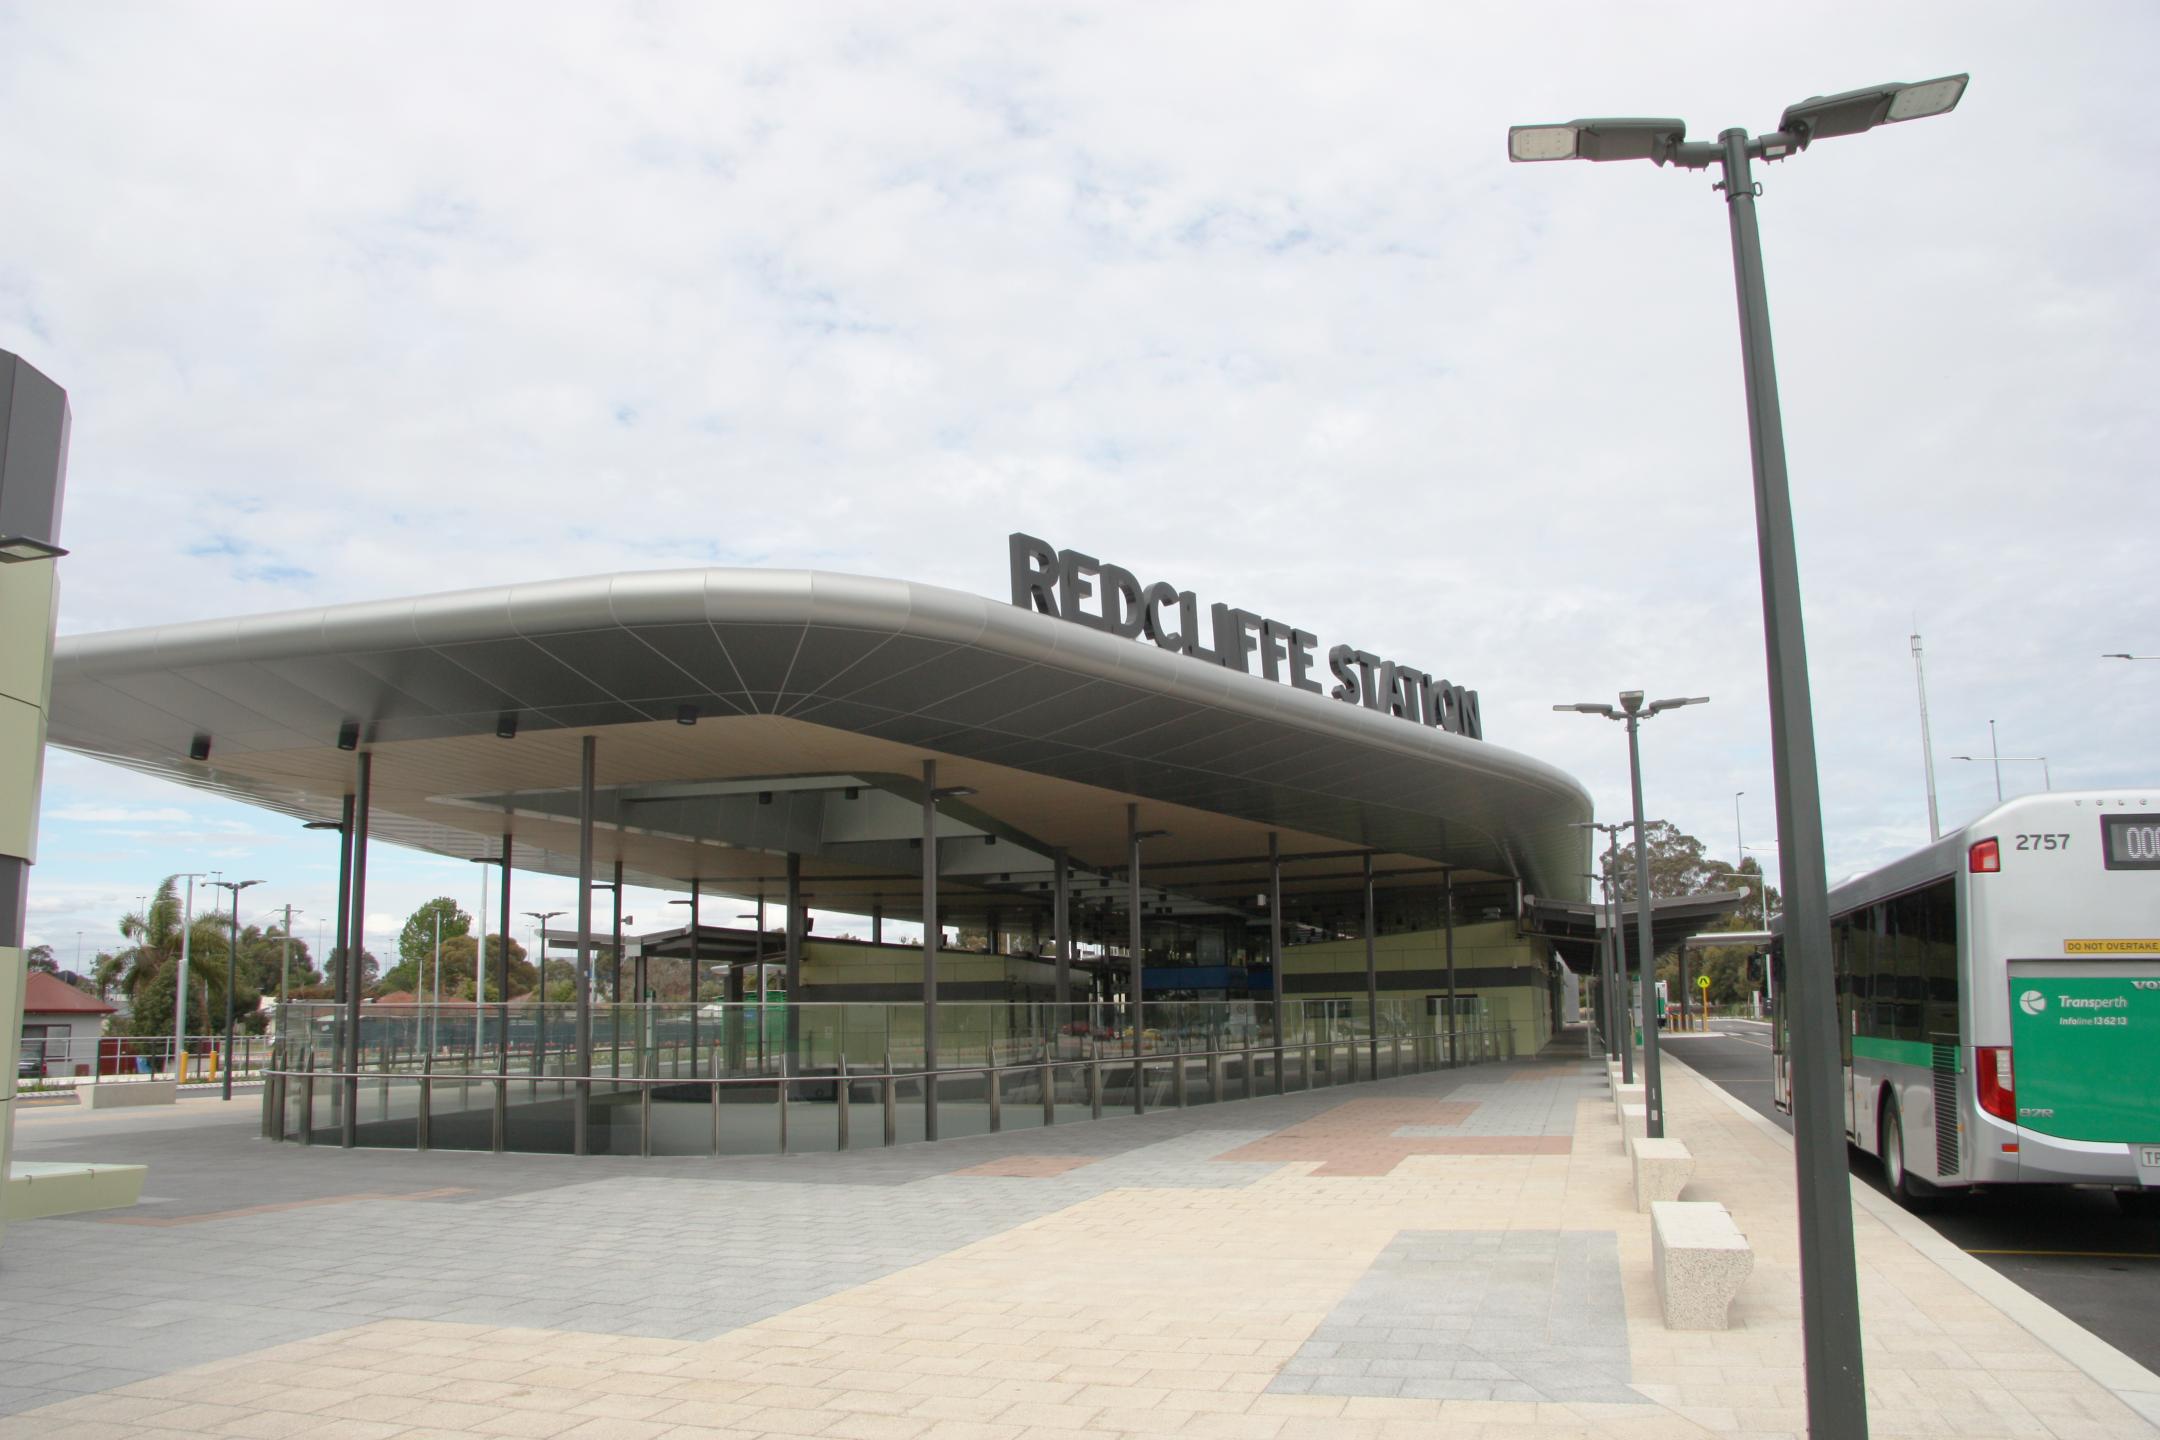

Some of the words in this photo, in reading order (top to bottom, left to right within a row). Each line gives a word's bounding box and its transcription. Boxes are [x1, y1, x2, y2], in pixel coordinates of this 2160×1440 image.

[1009, 532, 1323, 695] REDCLIFFE
[1329, 644, 1482, 741] STATION
[2015, 833, 2071, 851] 2757
[2067, 942, 2081, 951] DO
[2084, 942, 2104, 951] NOT
[2106, 942, 2159, 951] OVERTAKE
[2058, 995, 2129, 1011] Transperth
[2059, 1016, 2093, 1026] Infoline
